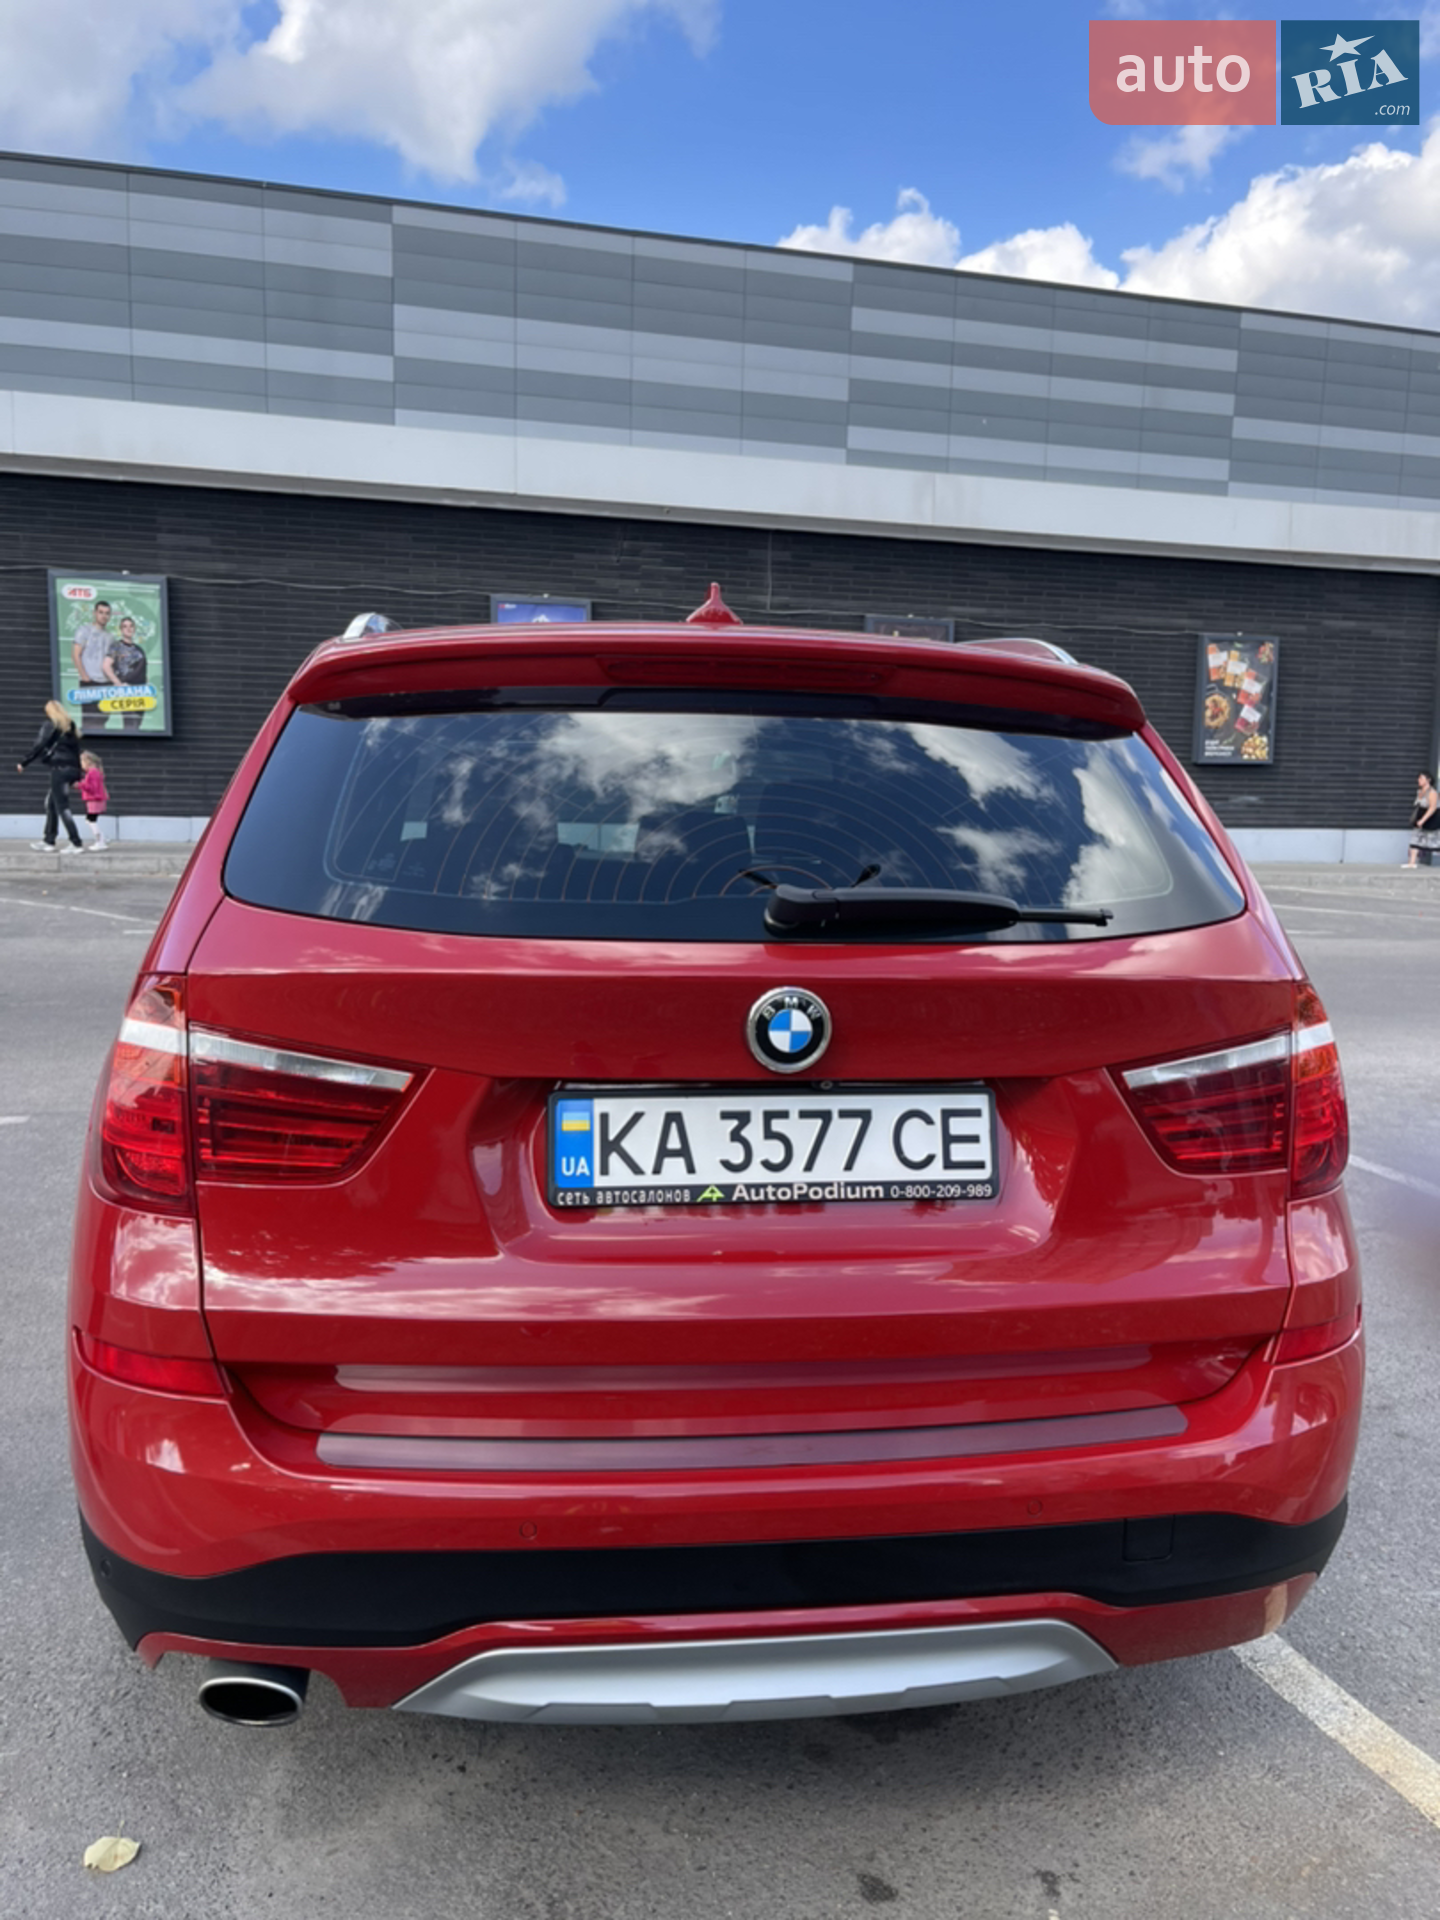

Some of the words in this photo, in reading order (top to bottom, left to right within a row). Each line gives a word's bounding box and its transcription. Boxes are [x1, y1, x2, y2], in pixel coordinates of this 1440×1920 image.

[762, 996, 822, 1020] BMW
[599, 1110, 697, 1176] KA
[719, 1108, 873, 1174] 3577
[892, 1107, 986, 1171] CE
[561, 1156, 591, 1177] UA
[557, 1190, 591, 1206] сеть
[596, 1188, 692, 1205] автосалонов
[732, 1182, 885, 1202] AutoPodium
[890, 1184, 993, 1198] 0-800-209-989
